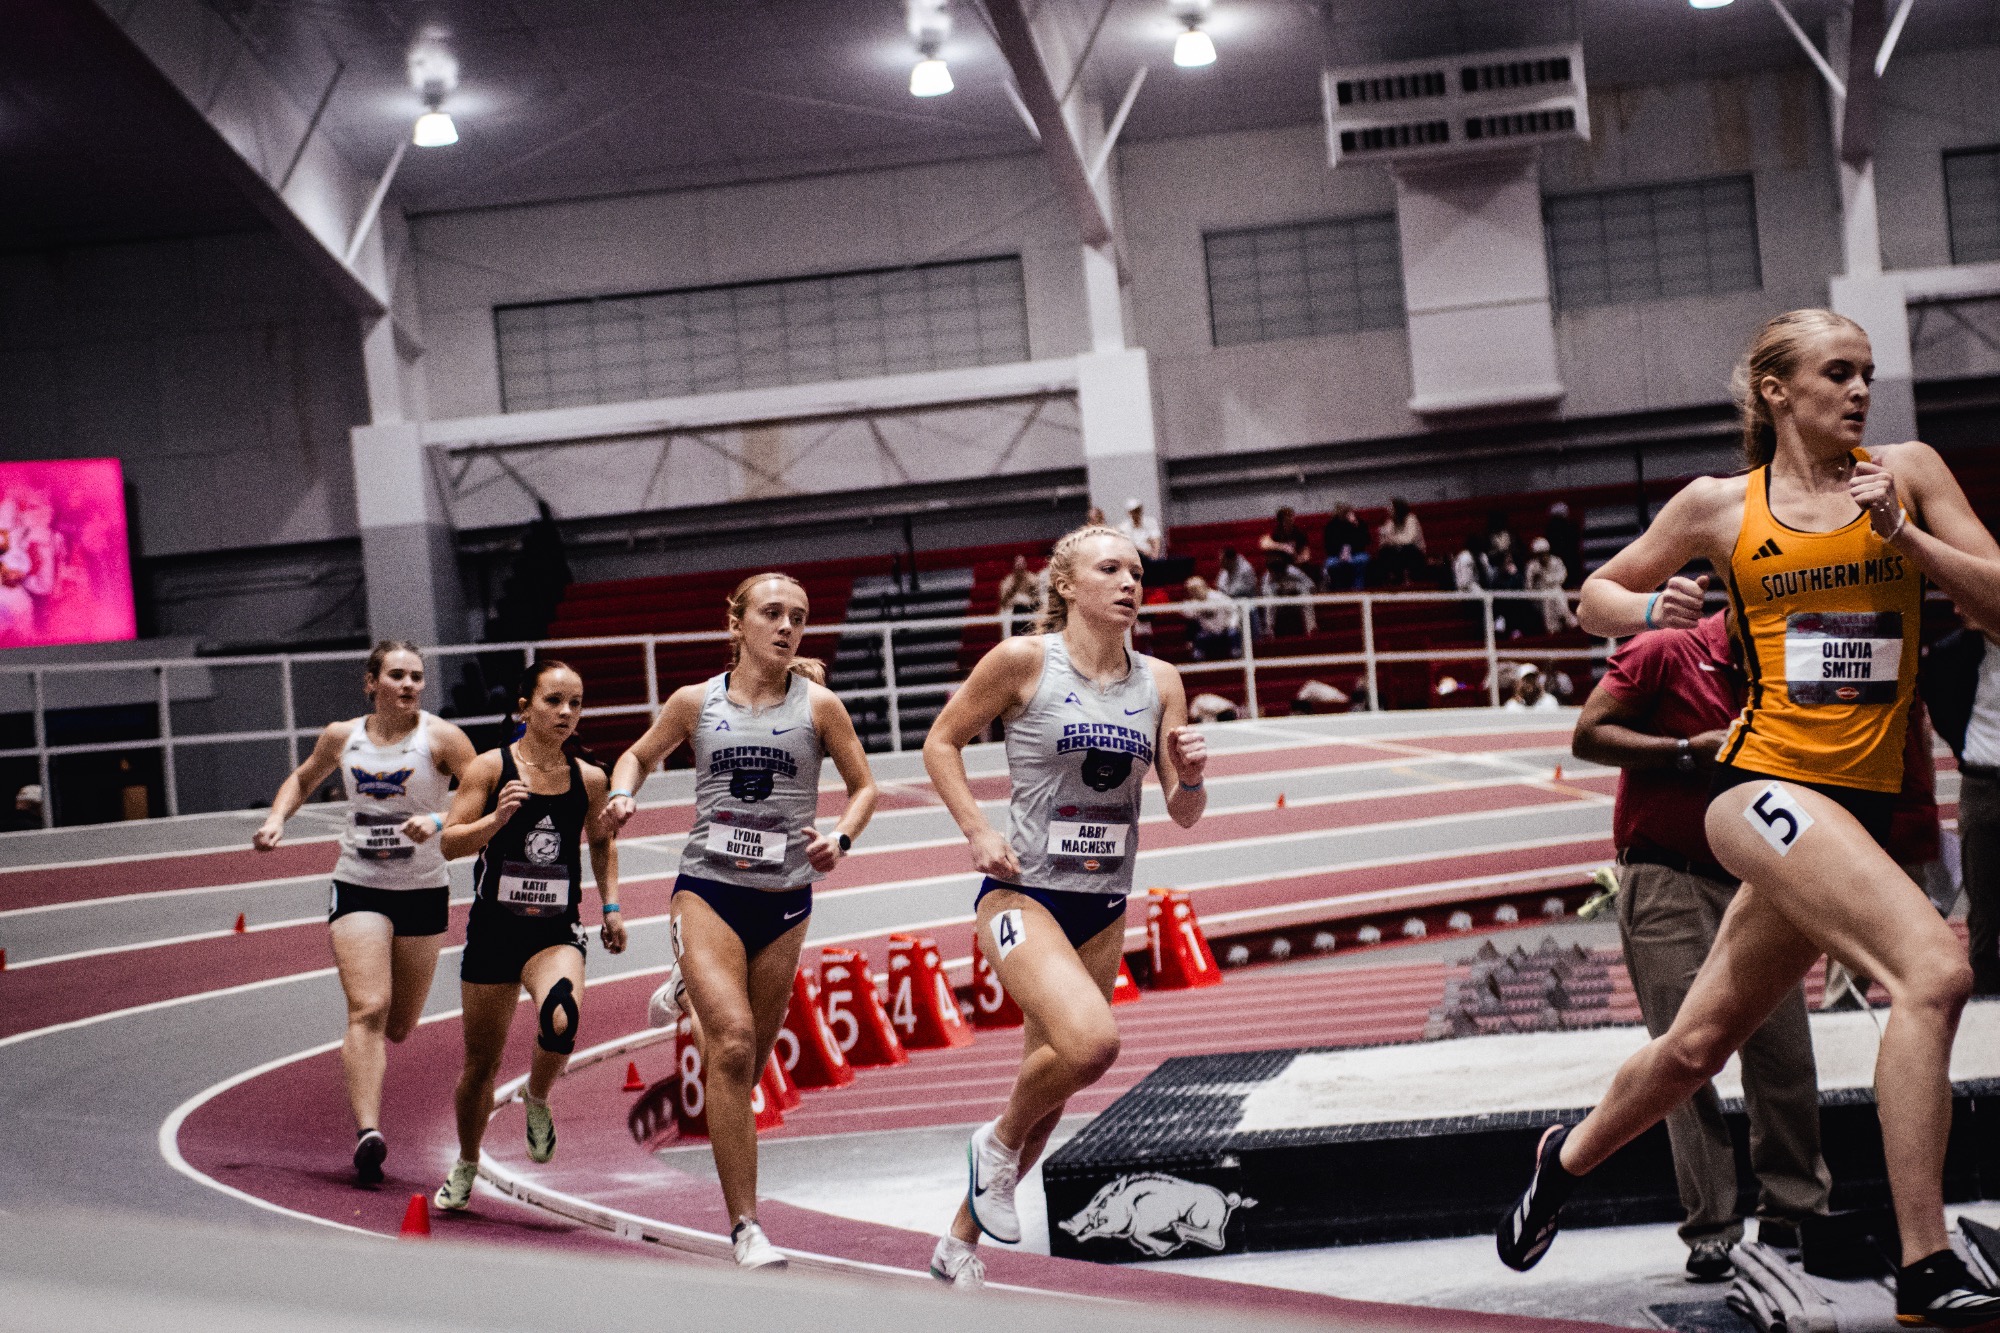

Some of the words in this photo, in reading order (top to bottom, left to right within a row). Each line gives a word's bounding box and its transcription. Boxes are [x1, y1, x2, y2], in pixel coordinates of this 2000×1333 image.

[1761, 563, 1861, 601] SOUTHERN
[1864, 555, 1904, 585] MISS
[1822, 641, 1872, 659] OLIVIA
[1822, 661, 1871, 679] SMITH
[1063, 723, 1151, 747] CENTRAL
[712, 745, 796, 764] CENTRAL
[709, 756, 798, 777] ARKANSAS
[1752, 790, 1799, 846] 5
[733, 828, 762, 844] LYDIA
[1078, 825, 1108, 839] ABBY
[726, 840, 764, 858] BUTLER
[1061, 839, 1117, 854] MACHESKY
[509, 890, 557, 903] LANGFORD
[522, 880, 548, 892] KATIE
[1000, 911, 1018, 948] 4
[1180, 921, 1207, 972] 1
[978, 958, 1004, 1013] 3
[893, 975, 918, 1034] 4
[935, 971, 961, 1027] 4
[828, 989, 859, 1053] 5
[681, 1044, 704, 1118] 8
